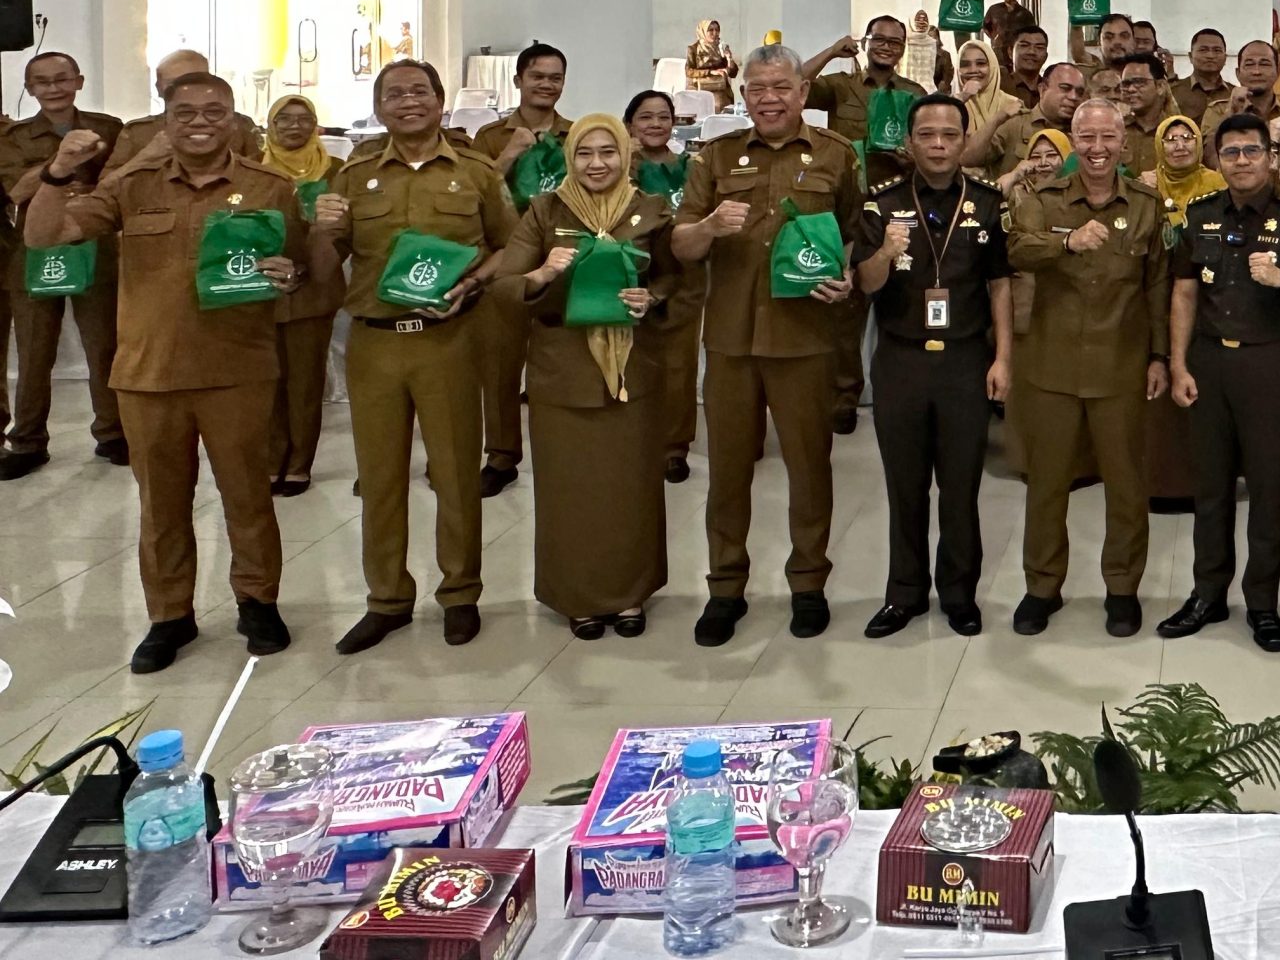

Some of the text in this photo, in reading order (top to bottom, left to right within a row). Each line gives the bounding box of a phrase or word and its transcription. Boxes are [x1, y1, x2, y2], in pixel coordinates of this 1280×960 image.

[924, 798, 954, 813] BU
[55, 859, 119, 871] ASHLEY
[907, 885, 999, 906] BU MIMIN
[378, 897, 404, 921] BU
